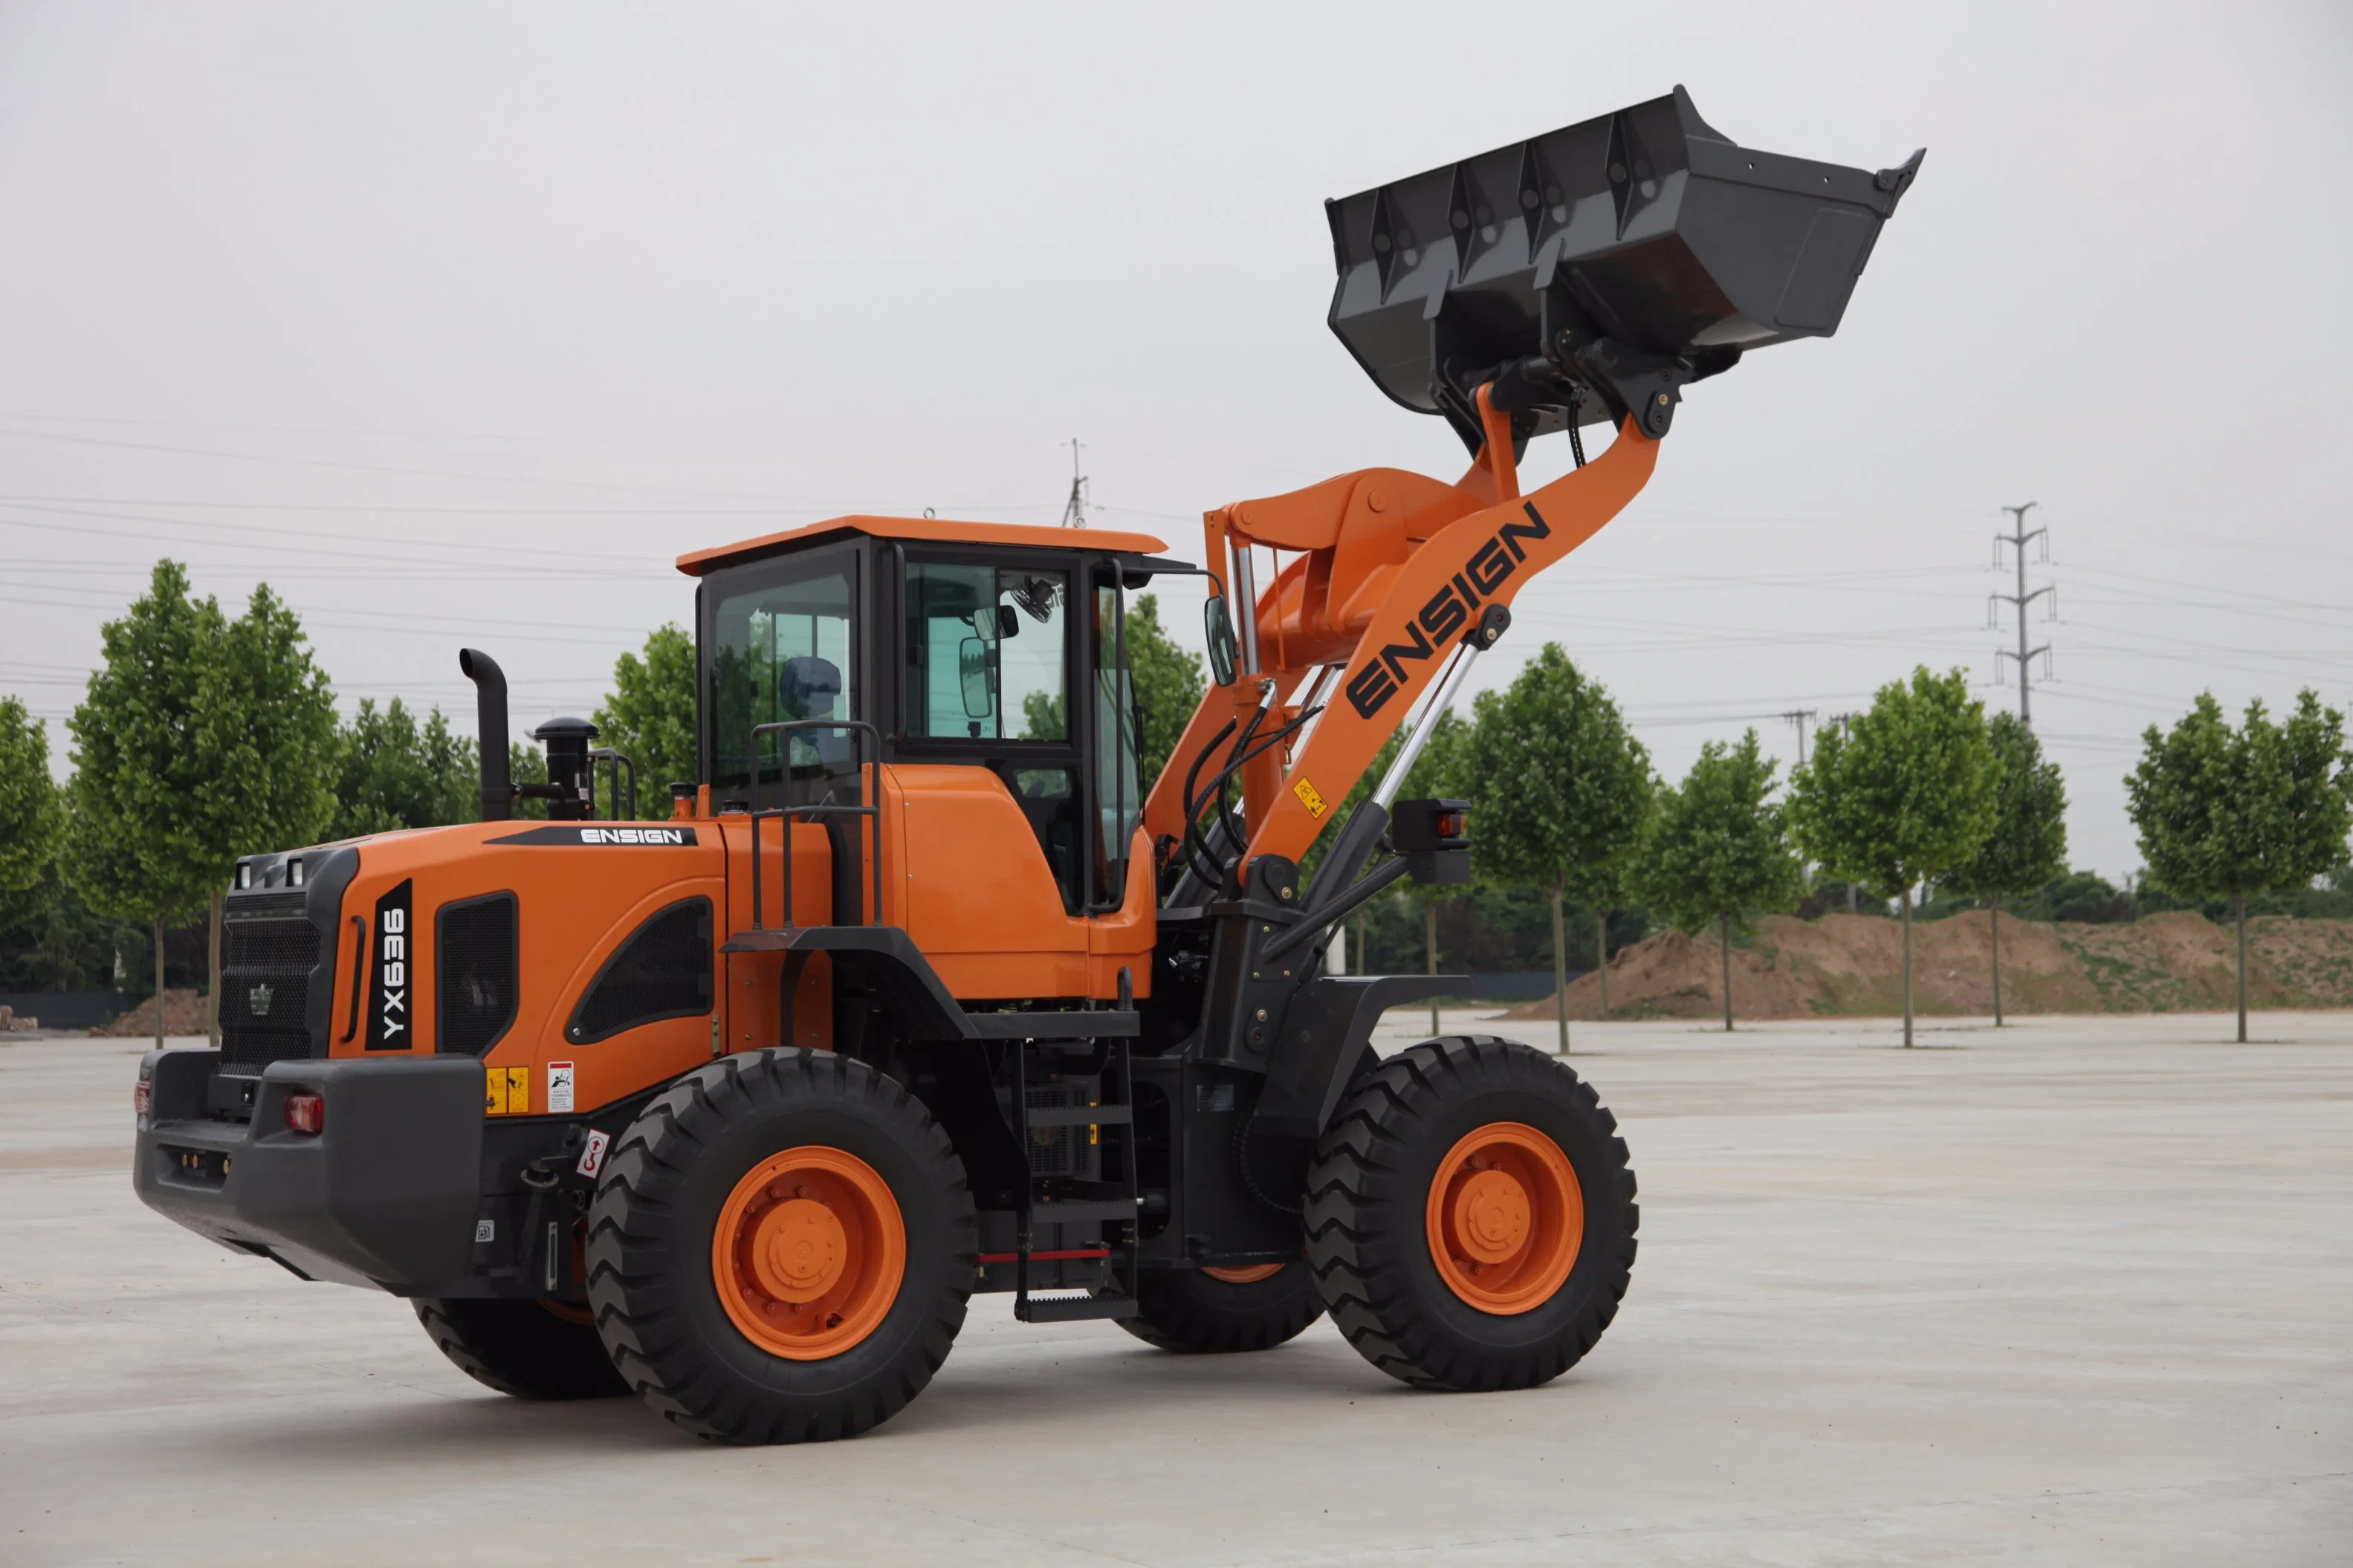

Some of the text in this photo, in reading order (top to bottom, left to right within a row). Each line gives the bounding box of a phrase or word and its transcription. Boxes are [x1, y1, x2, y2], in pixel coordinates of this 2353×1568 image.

[1346, 500, 1551, 719] ENSIGN
[580, 829, 683, 843] ENSIGN
[383, 908, 404, 1040] YX636
